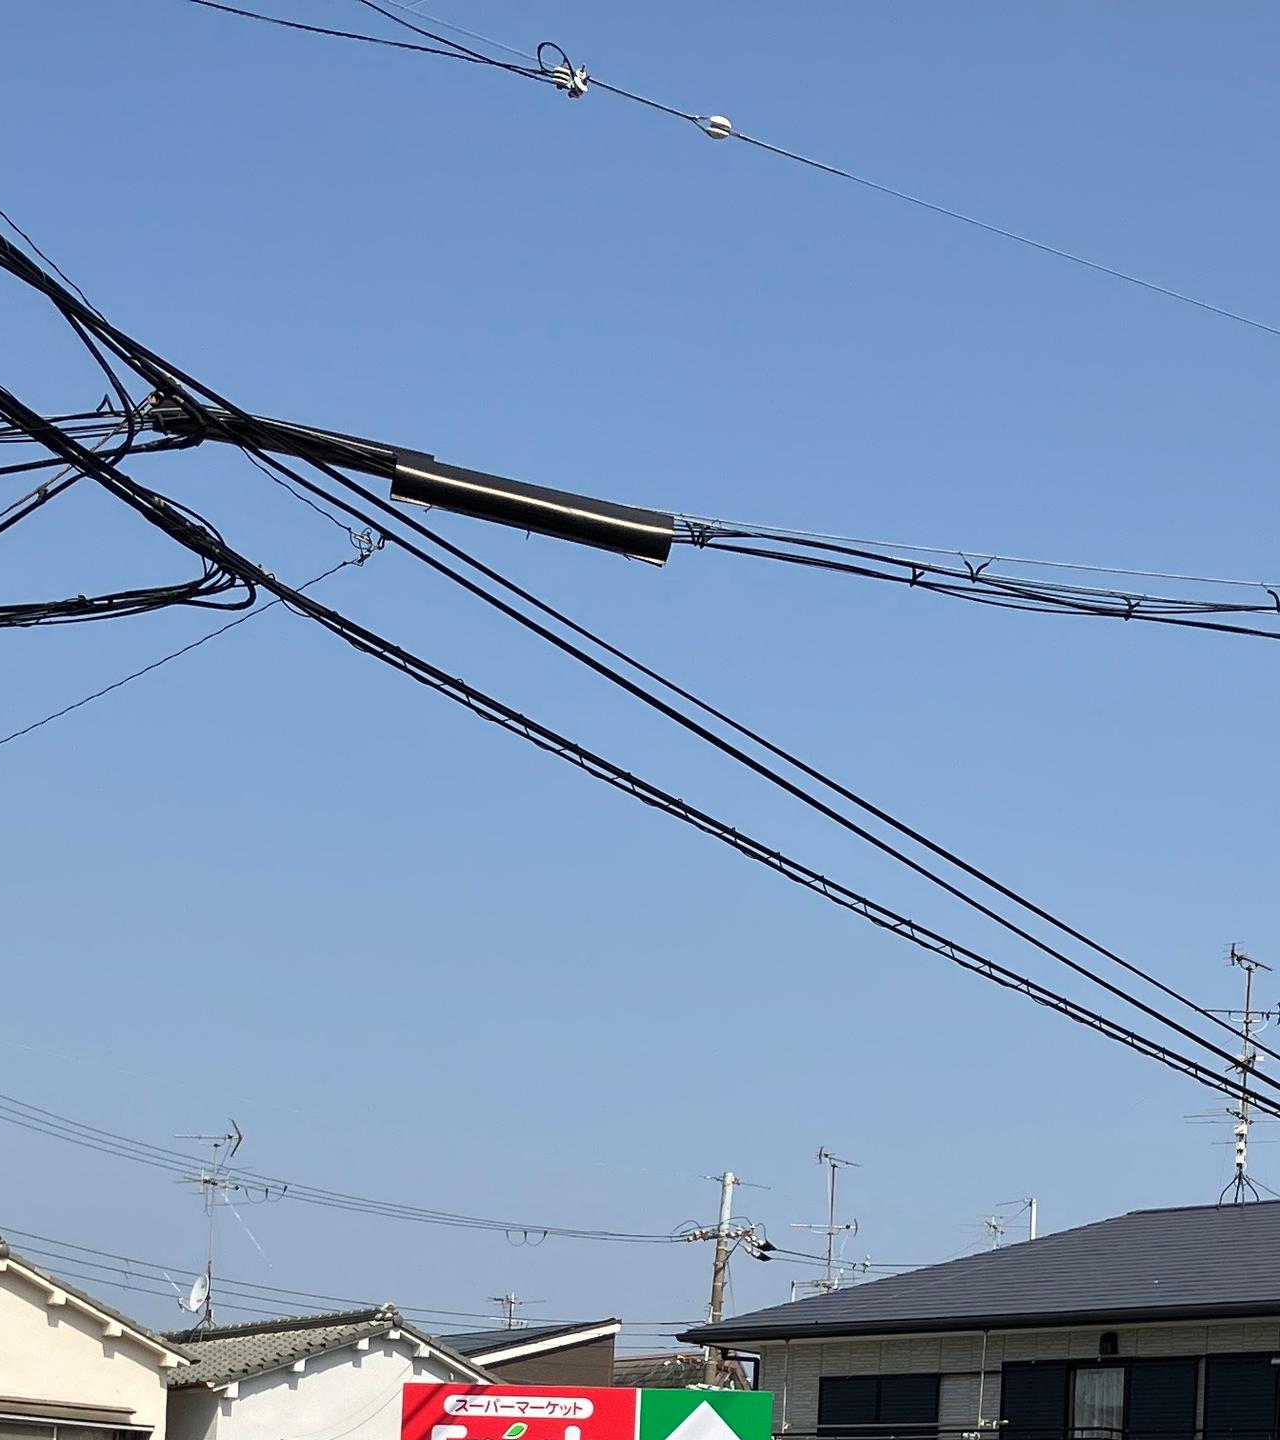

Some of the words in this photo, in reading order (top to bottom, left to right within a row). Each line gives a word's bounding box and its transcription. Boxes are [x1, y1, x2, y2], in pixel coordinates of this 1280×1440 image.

[455, 1398, 584, 1416] スーパーマーケット
